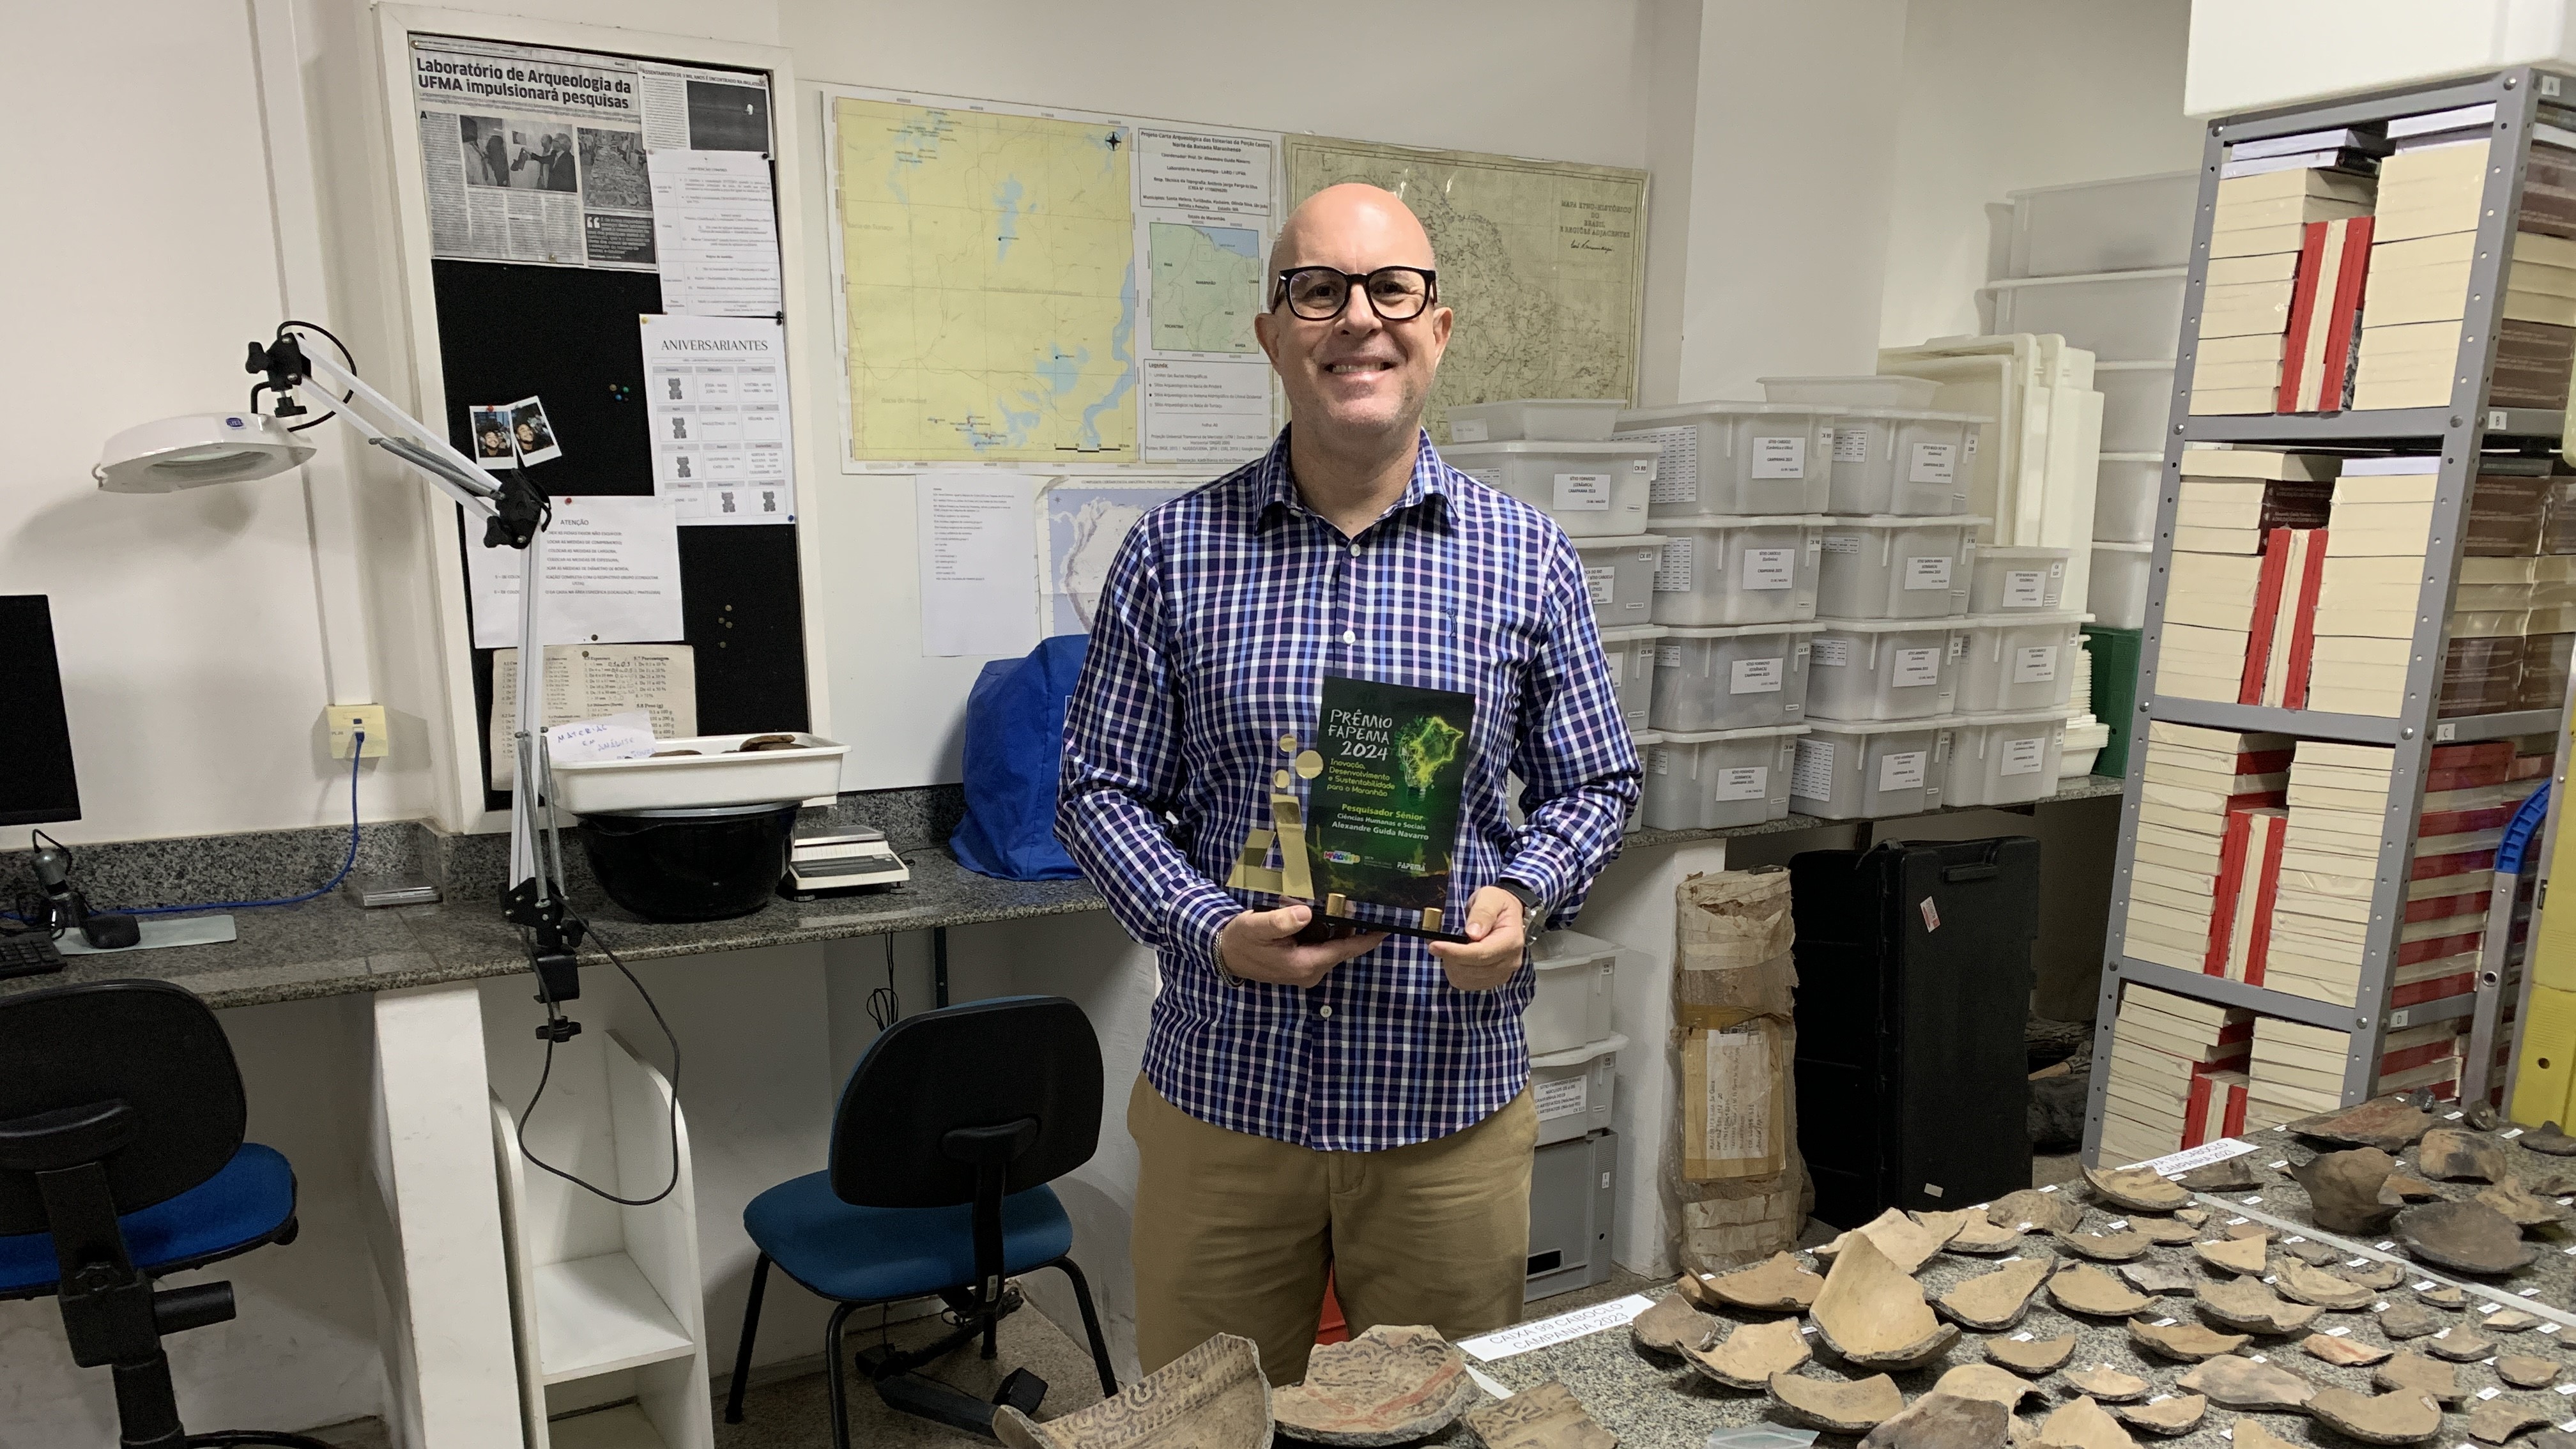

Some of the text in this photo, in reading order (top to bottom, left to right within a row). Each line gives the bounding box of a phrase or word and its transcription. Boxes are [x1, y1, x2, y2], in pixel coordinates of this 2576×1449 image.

[417, 57, 631, 94] Laboratório de Arqueologia da
[418, 74, 463, 91] UFMA
[466, 79, 559, 101] impulsionará
[563, 91, 629, 110] pesquisas
[2549, 82, 2554, 92] A
[420, 111, 427, 119] A
[1172, 134, 1202, 142] Arqueológica
[661, 340, 768, 351] ANIVERSARIANTES
[2496, 415, 2500, 426] B
[1330, 709, 1393, 729] PRÊMIO
[1328, 724, 1390, 745] FAPEMA
[2444, 728, 2448, 737] C
[1340, 740, 1388, 761] 2024
[1331, 758, 1365, 769] Inovação,
[1329, 767, 1390, 781] Desenvolvimento
[1335, 775, 1395, 790] Sustentabilidade
[1352, 786, 1388, 797] Maranhão
[1342, 803, 1423, 821] Pesquisador Sênior
[1331, 821, 1429, 840] Alexandre Guida Navarro
[1337, 813, 1364, 822] Ciências
[1365, 817, 1395, 826] Humanas
[1403, 822, 1426, 831] Sociais
[2181, 1142, 2228, 1158] CABOCLO
[2159, 1149, 2235, 1172] CAMPANHA 2023
[1490, 1303, 1623, 1345] CAIXA 99 CABOCLO
[1513, 1312, 1629, 1350] CAMPANHA 2023
